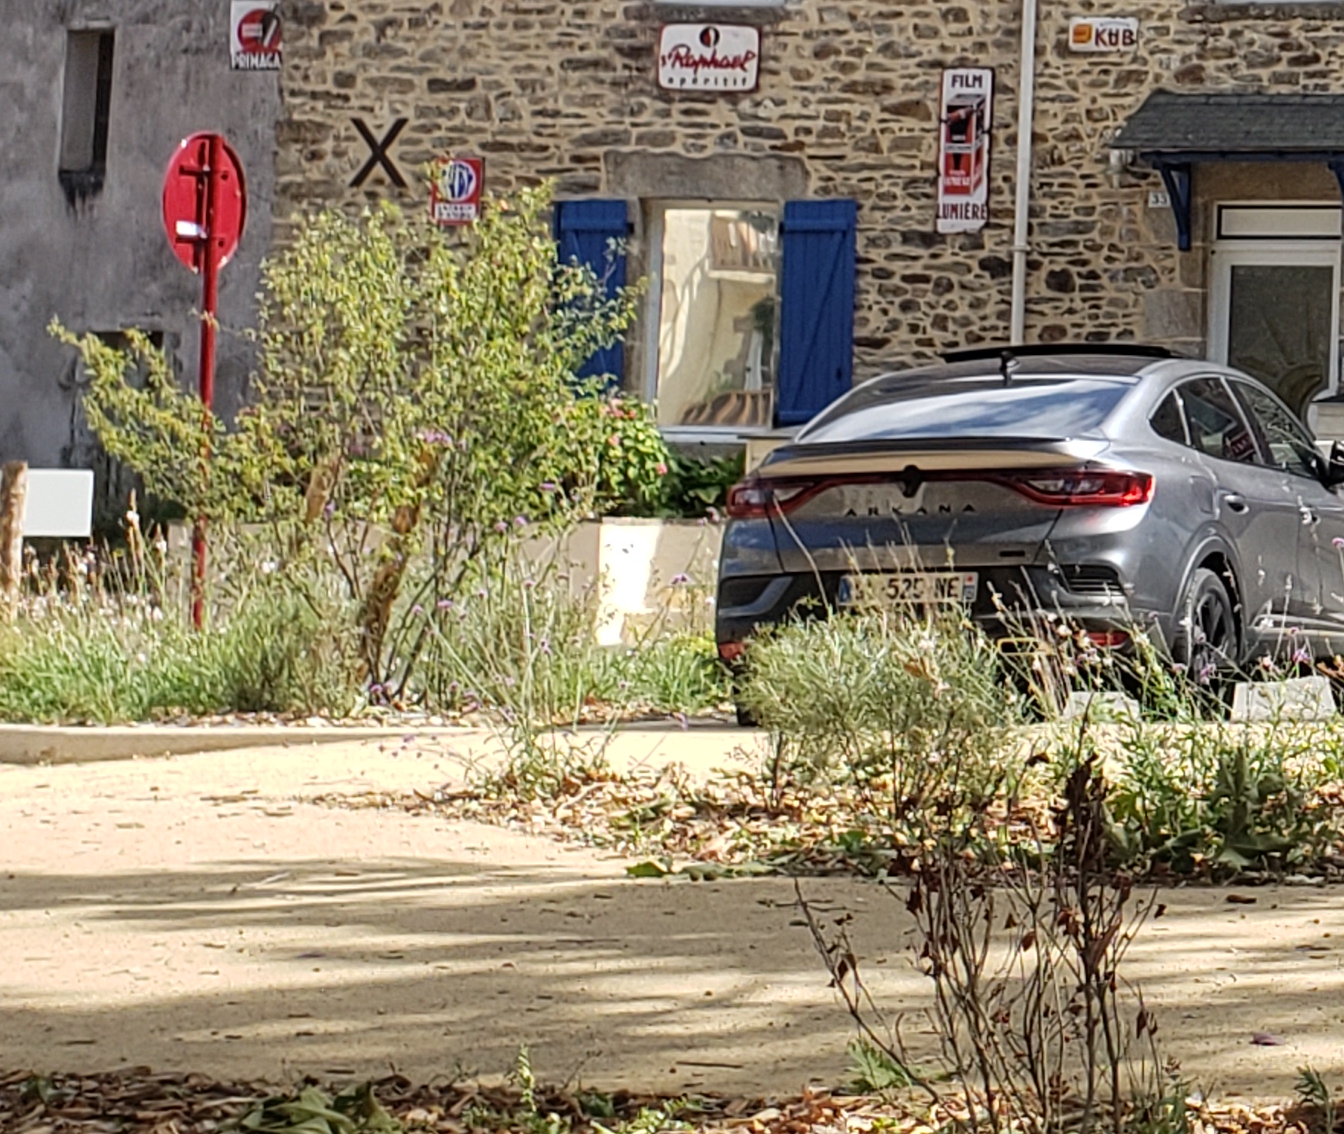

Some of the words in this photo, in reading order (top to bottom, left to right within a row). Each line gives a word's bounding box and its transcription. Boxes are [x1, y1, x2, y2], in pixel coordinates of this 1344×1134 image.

[1095, 28, 1135, 47] KUB
[951, 74, 983, 89] FILM
[845, 504, 977, 517] ARKANA
